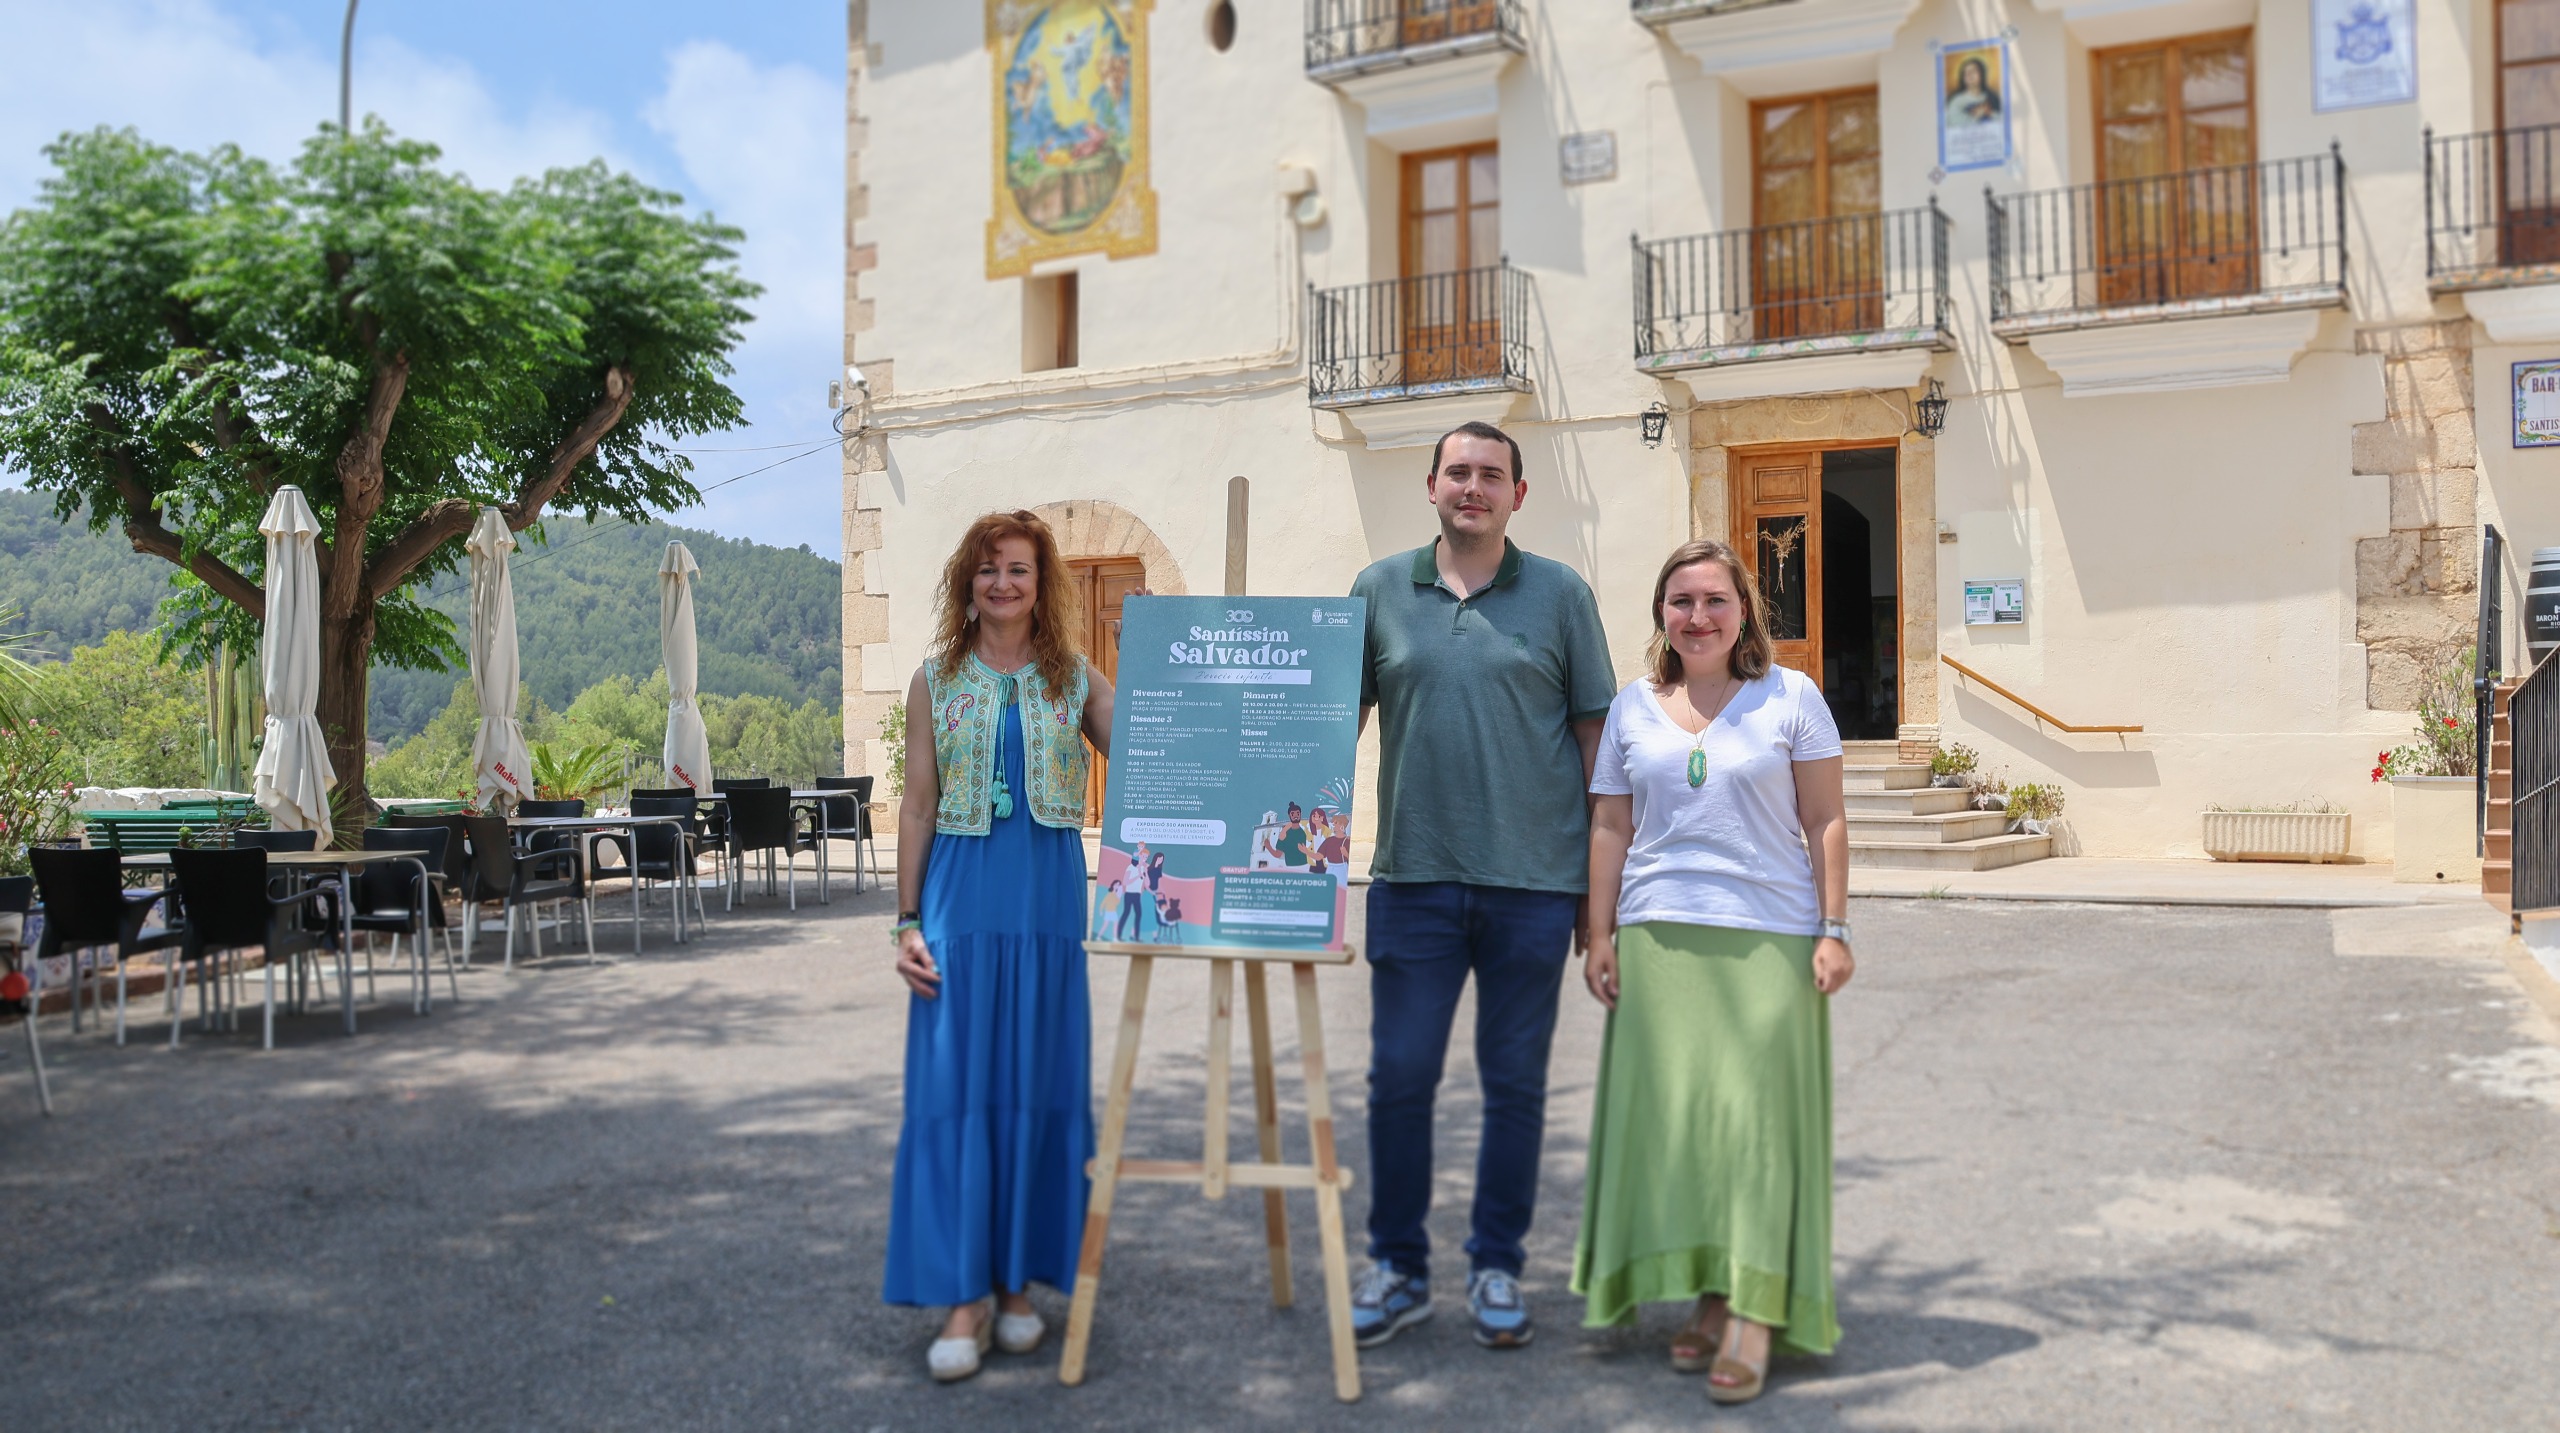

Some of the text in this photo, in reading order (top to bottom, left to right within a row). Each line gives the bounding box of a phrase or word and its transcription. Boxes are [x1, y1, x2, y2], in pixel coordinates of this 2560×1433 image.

[1189, 626, 1290, 642] Santíssim
[1169, 642, 1308, 665] Salvador
[1243, 691, 1278, 699] Dimarts
[494, 762, 518, 785] Maho
[1285, 878, 1327, 887] D'AUTOBÚS
